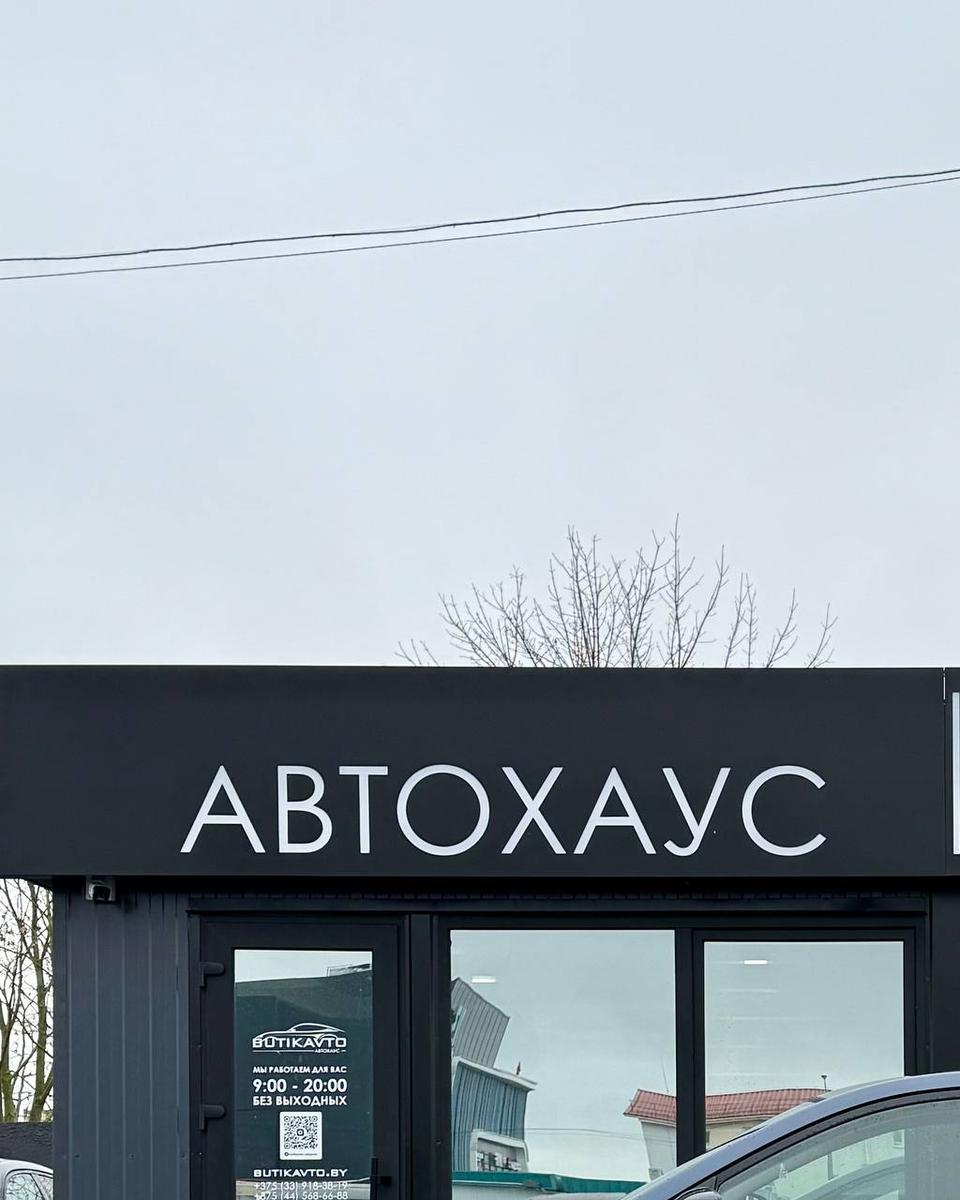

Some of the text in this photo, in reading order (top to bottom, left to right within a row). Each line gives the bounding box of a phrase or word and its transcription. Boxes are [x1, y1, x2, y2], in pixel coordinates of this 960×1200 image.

[180, 764, 827, 858] АВТОХАУС
[252, 1037, 347, 1048] BUTIKAVTO
[252, 1066, 267, 1074] МЫ
[268, 1066, 311, 1074] РАБОТАЕМ
[311, 1066, 328, 1074] ДЛЯ
[252, 1078, 287, 1093] 9:00
[303, 1078, 348, 1093] 20:00
[252, 1095, 348, 1107] БЕЗ ВЫХОДНЫХ
[253, 1169, 348, 1177] BUTIKAVTO.BY
[281, 1181, 299, 1192] (33)
[301, 1181, 348, 1191] 918-38-19
[301, 1191, 349, 1200] 568-66-88
